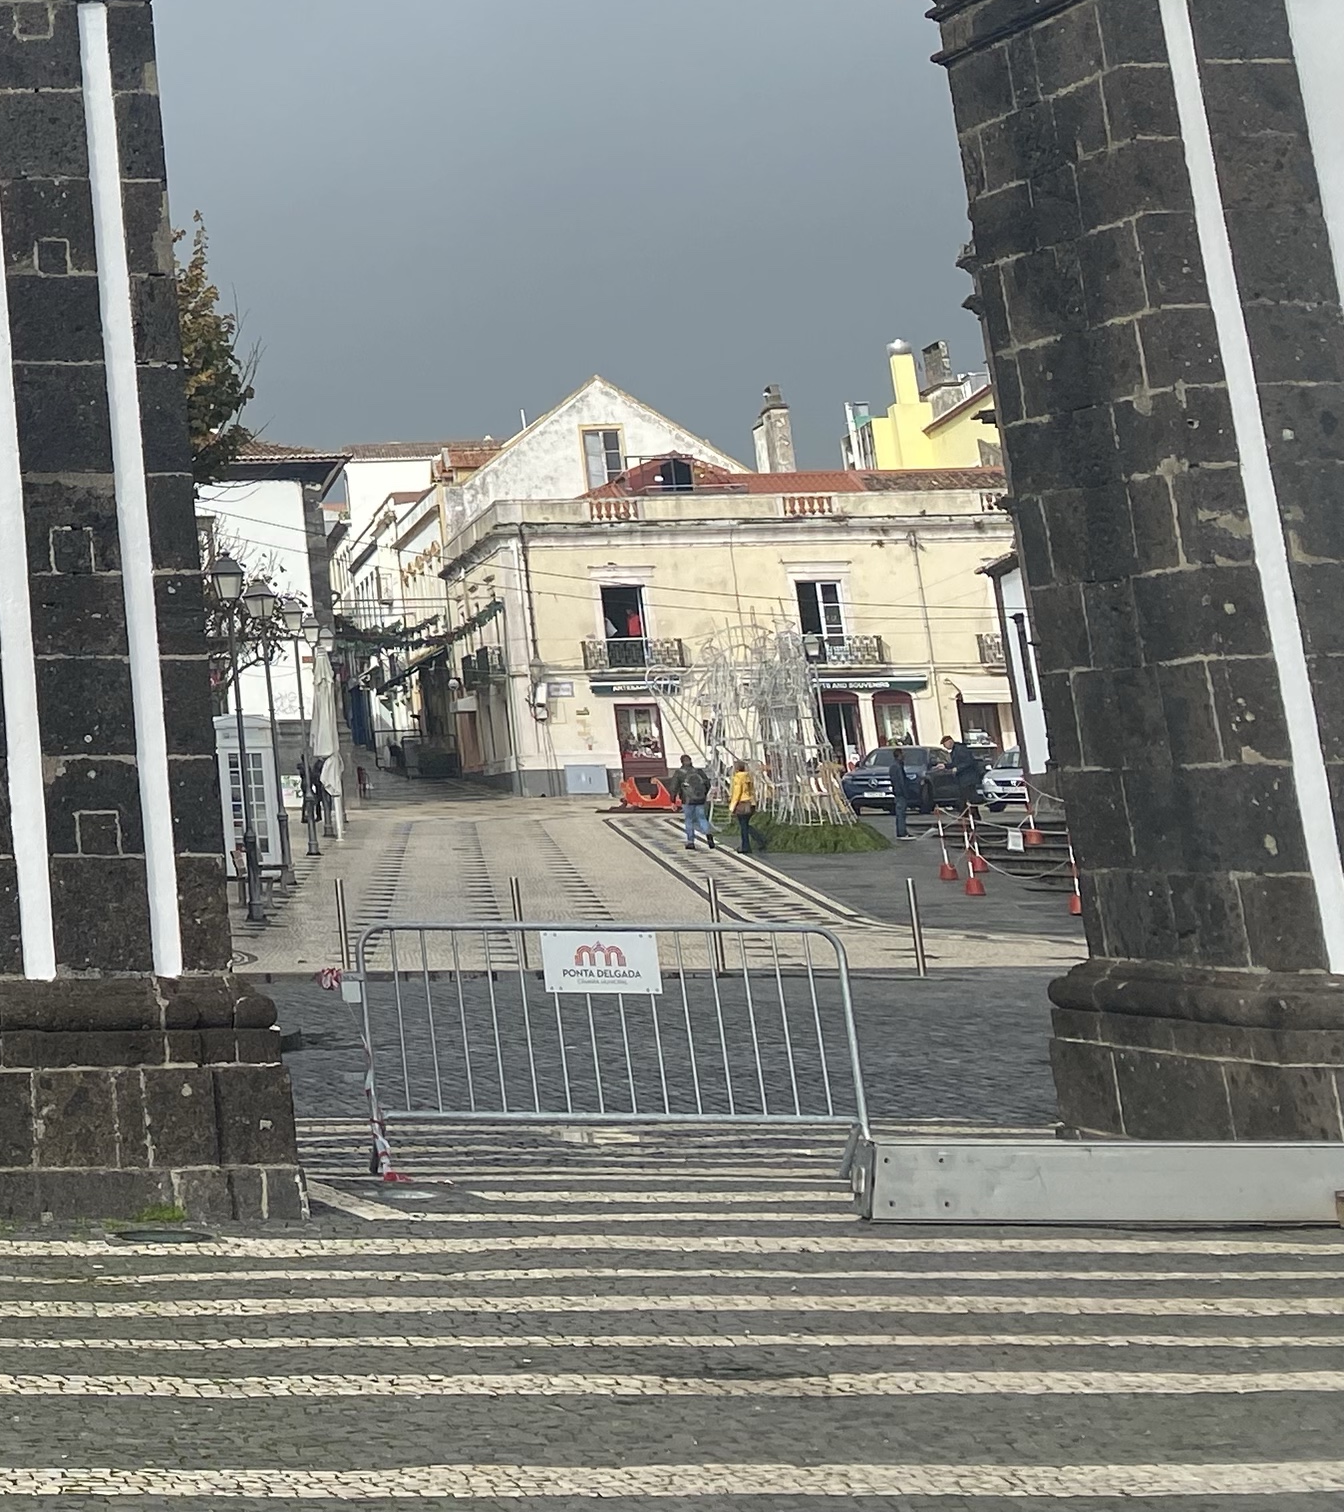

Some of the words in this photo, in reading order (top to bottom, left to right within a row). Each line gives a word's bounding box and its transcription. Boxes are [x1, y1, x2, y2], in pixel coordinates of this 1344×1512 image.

[848, 681, 890, 689] SOUVENIRS
[562, 968, 595, 978] PONTA
[596, 969, 642, 979] DELGADA
